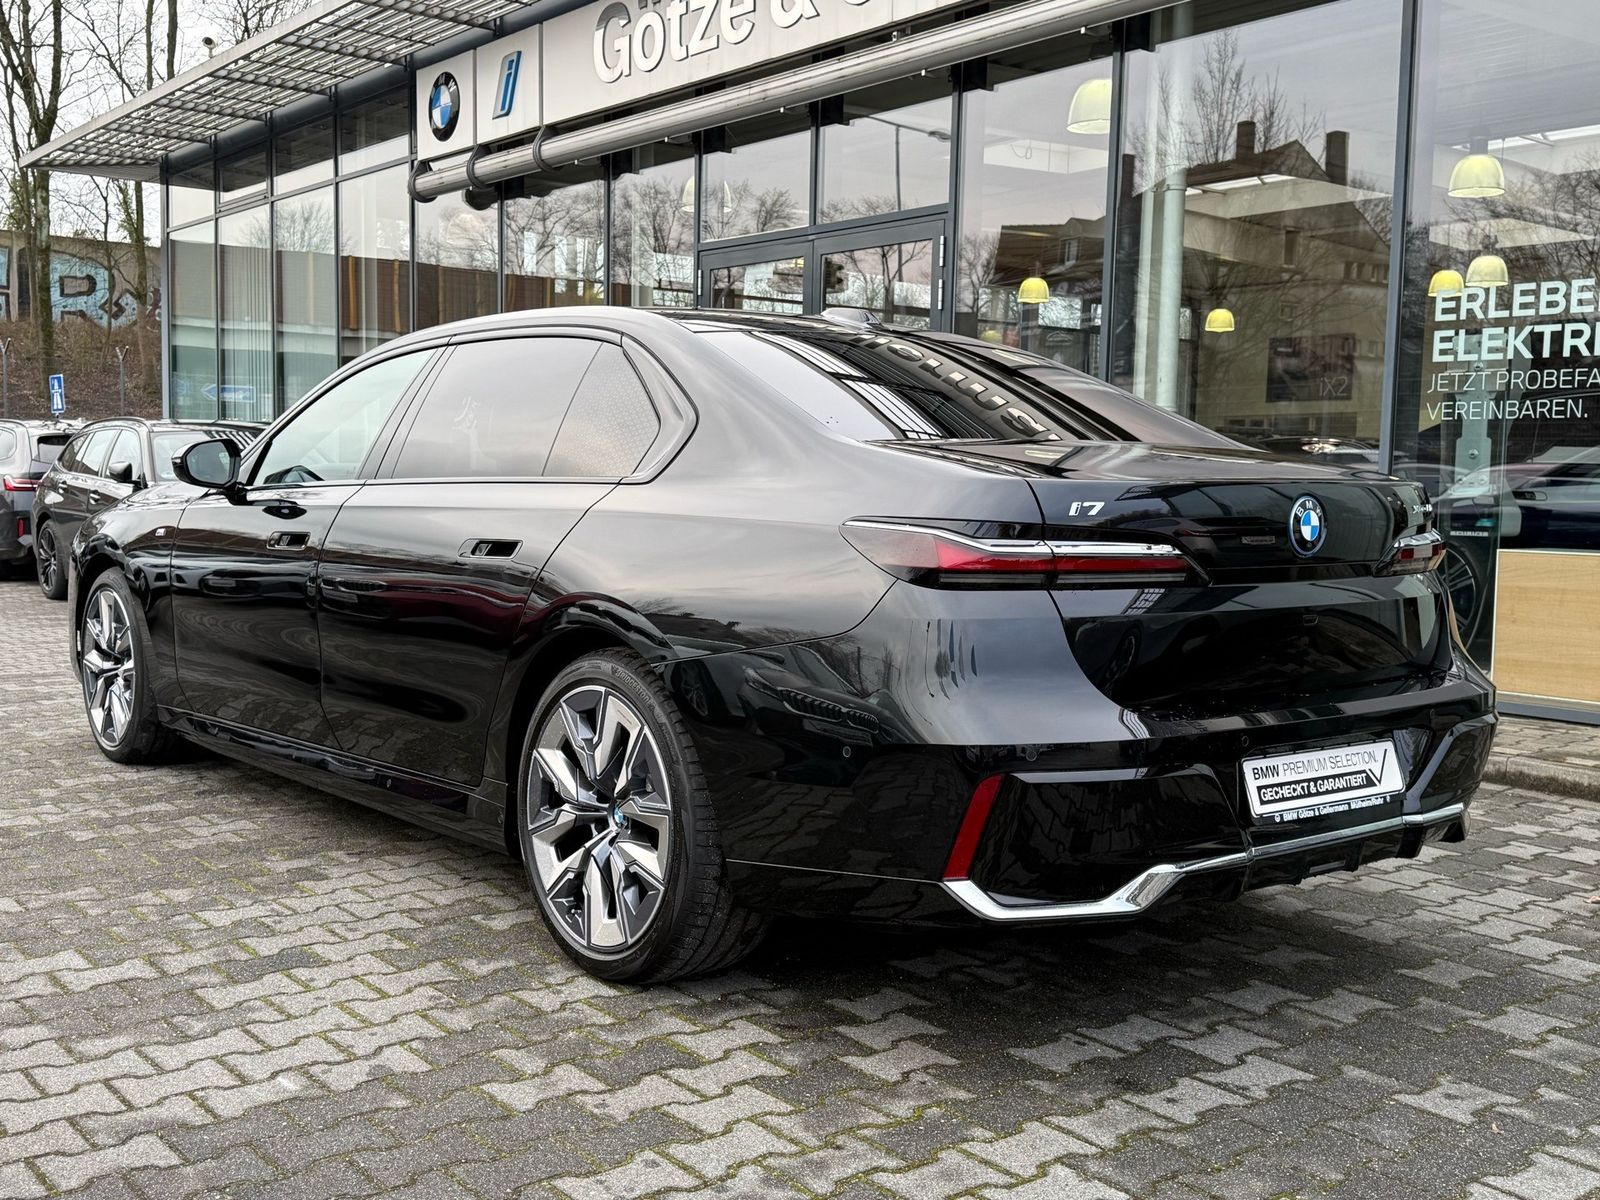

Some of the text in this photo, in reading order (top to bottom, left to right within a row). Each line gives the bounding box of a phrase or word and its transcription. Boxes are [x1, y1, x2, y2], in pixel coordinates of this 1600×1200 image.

[593, 0, 756, 83] Götze
[1434, 278, 1600, 322] ERLEBE
[1320, 376, 1347, 397] iX2
[1426, 371, 1491, 394] JETZT
[1426, 398, 1588, 421] VEREINBAREN.
[1068, 501, 1105, 516] i7
[1252, 750, 1378, 781] BMW PREMIUM SELECTION.
[1260, 773, 1367, 802] GECHECKT & GARANTIERT
[1283, 811, 1298, 821] BMW
